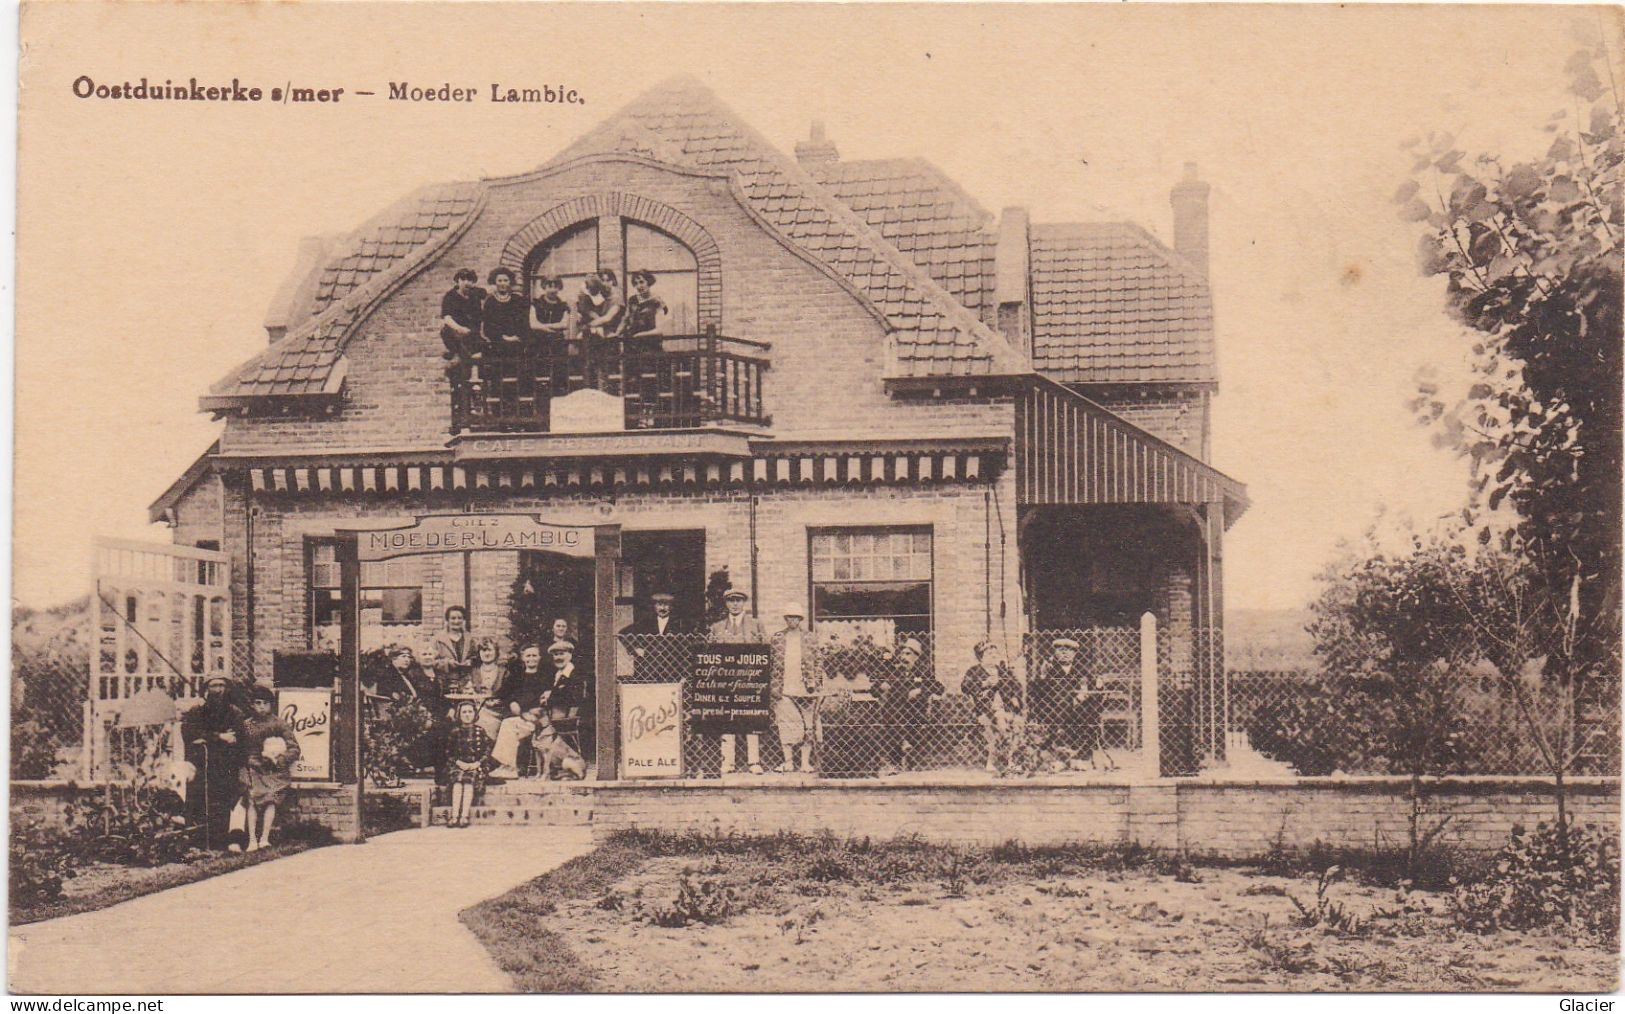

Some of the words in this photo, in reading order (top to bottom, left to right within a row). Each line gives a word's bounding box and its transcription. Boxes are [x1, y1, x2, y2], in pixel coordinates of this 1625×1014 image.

[548, 435, 704, 450] RESTAURANT
[697, 654, 722, 665] TOUS
[737, 654, 769, 665] JOURS
[627, 692, 678, 743] Bass
[628, 758, 653, 767] PALE
[657, 757, 677, 767] ALE
